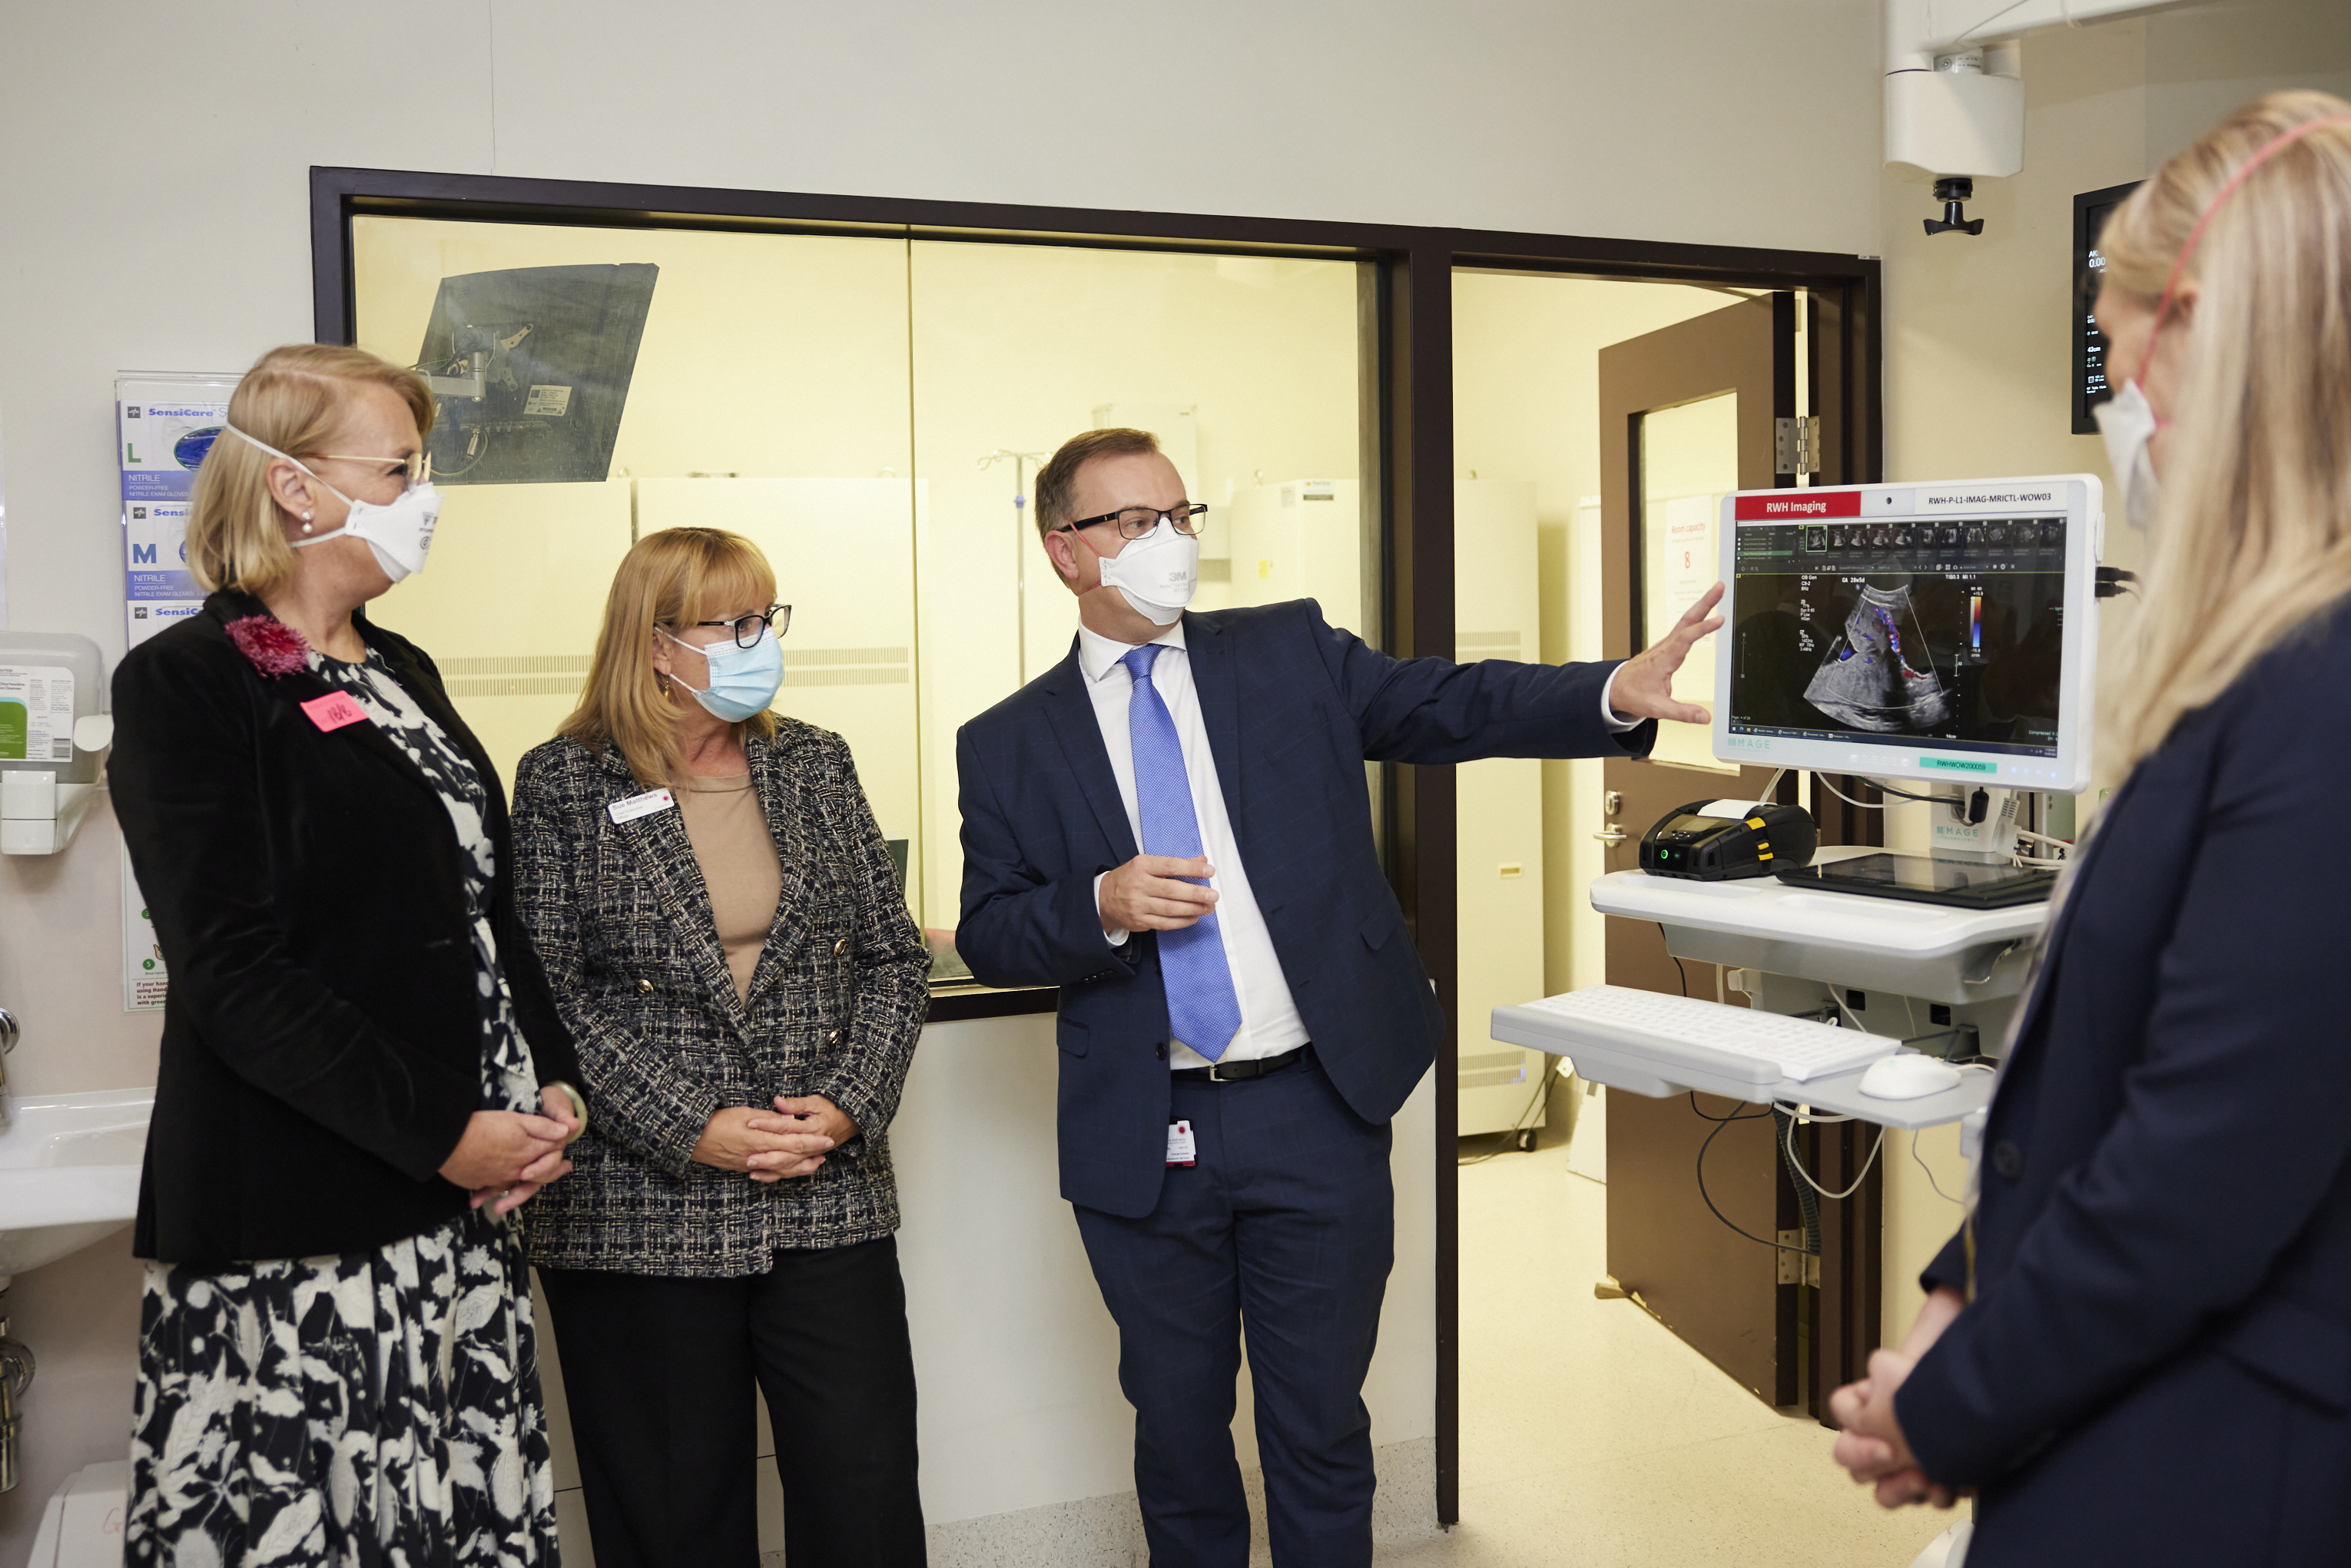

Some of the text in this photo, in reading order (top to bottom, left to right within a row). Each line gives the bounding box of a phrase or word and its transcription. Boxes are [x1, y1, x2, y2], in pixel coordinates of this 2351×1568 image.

[2088, 250, 2099, 258] AK:
[2089, 257, 2106, 268] 0.00
[149, 408, 214, 417] SensiCare
[128, 443, 142, 463] L
[1928, 493, 2051, 505] RWH-P-L1-IMAG-MRICTL-WOW03
[1766, 501, 1827, 514] RWH Imaging
[1671, 522, 1706, 534] Room capacity
[133, 544, 156, 564] M
[1684, 551, 1690, 569] 8
[1169, 571, 1187, 582] 3M
[612, 802, 625, 811] Sue
[626, 793, 658, 806] Matthews
